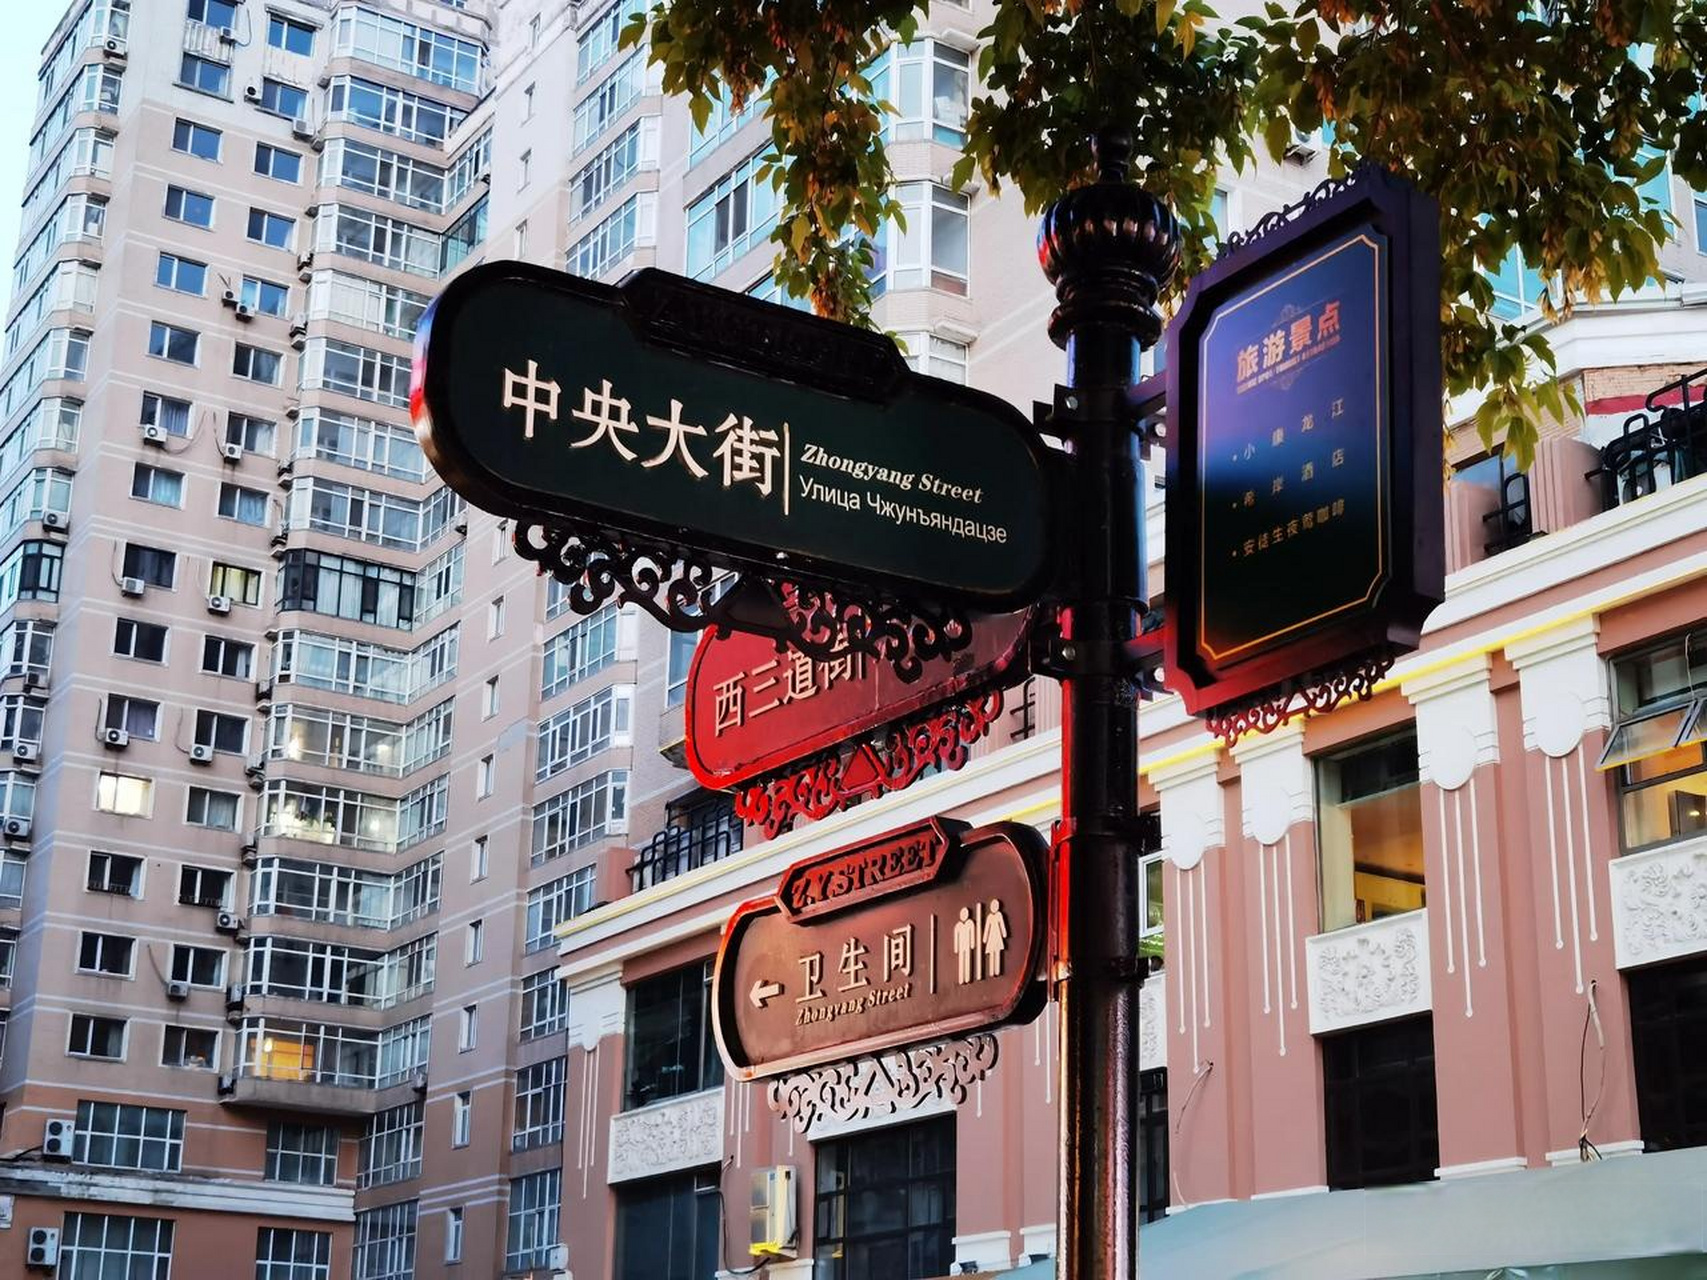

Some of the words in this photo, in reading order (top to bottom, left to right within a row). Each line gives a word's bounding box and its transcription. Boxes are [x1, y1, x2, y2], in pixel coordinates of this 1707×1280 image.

[1237, 300, 1340, 382] 旅游景点
[503, 359, 781, 497] 中央大街
[800, 443, 915, 490] Zhongyang
[918, 473, 984, 504] Street
[800, 475, 861, 511] Улица
[867, 491, 1007, 543] Чжунъяндацзе
[795, 923, 913, 1003] 卫生间
[796, 996, 863, 1026] Zhongyang
[868, 983, 911, 1009] Street
